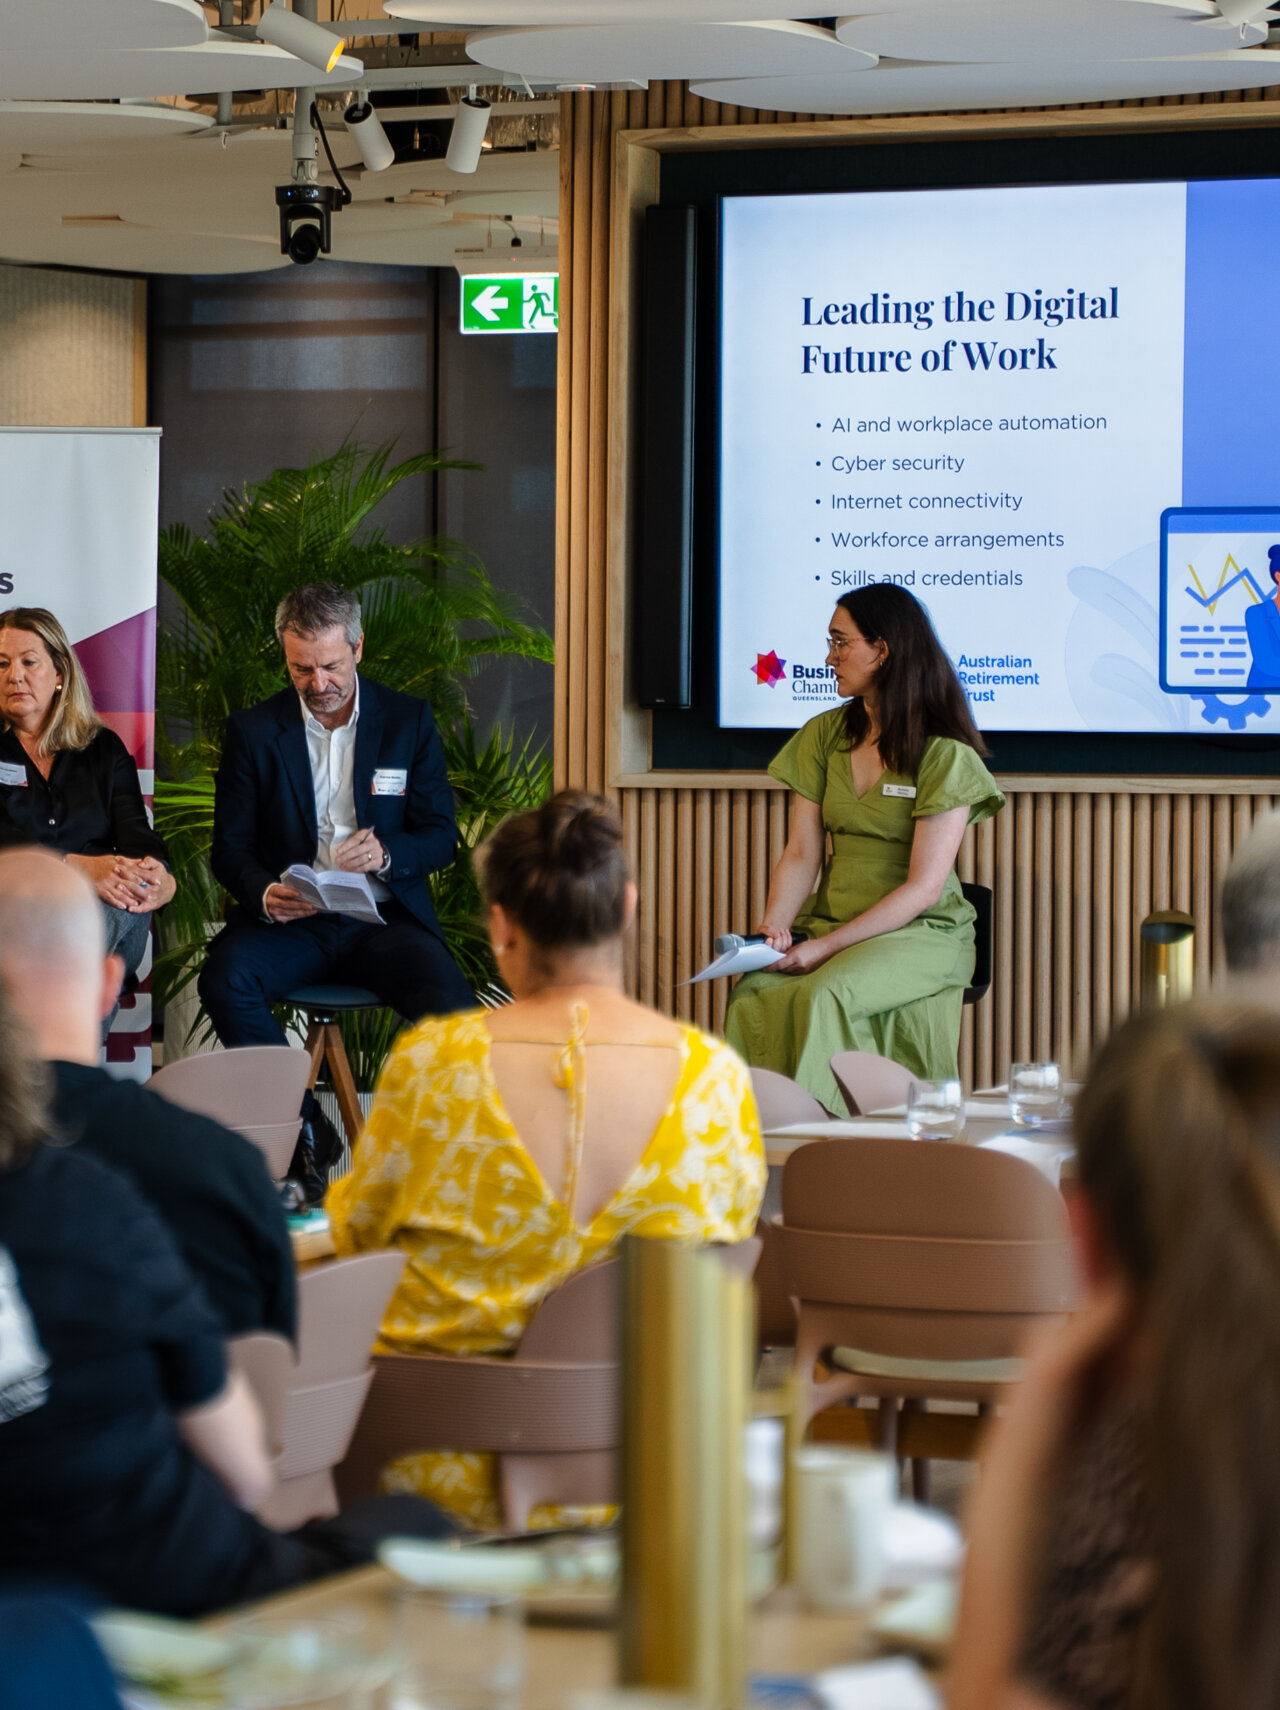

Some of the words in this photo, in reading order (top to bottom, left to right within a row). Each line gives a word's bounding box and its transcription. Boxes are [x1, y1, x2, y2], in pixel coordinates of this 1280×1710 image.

[801, 293, 934, 331] Leading
[942, 290, 996, 323] the
[1005, 286, 1120, 328] Digital
[801, 344, 912, 374] Future
[920, 339, 958, 372] of
[960, 338, 1058, 371] Work
[832, 417, 851, 433] AI
[856, 416, 891, 433] and
[897, 415, 993, 435] workplace
[998, 414, 1107, 431] automation
[831, 455, 886, 474] Cyber
[892, 454, 965, 473] security
[831, 494, 903, 510] Internet
[908, 492, 1023, 511] connectivity
[831, 531, 929, 548] Workforce
[934, 531, 1065, 551] arrangements
[830, 569, 876, 586] Skills
[880, 569, 916, 586] and
[921, 569, 1024, 586] credentials
[958, 654, 1033, 669] Australian
[792, 664, 835, 679] Busi
[958, 671, 1040, 686] Retirement
[791, 679, 837, 694] Cham
[962, 688, 996, 702] rust
